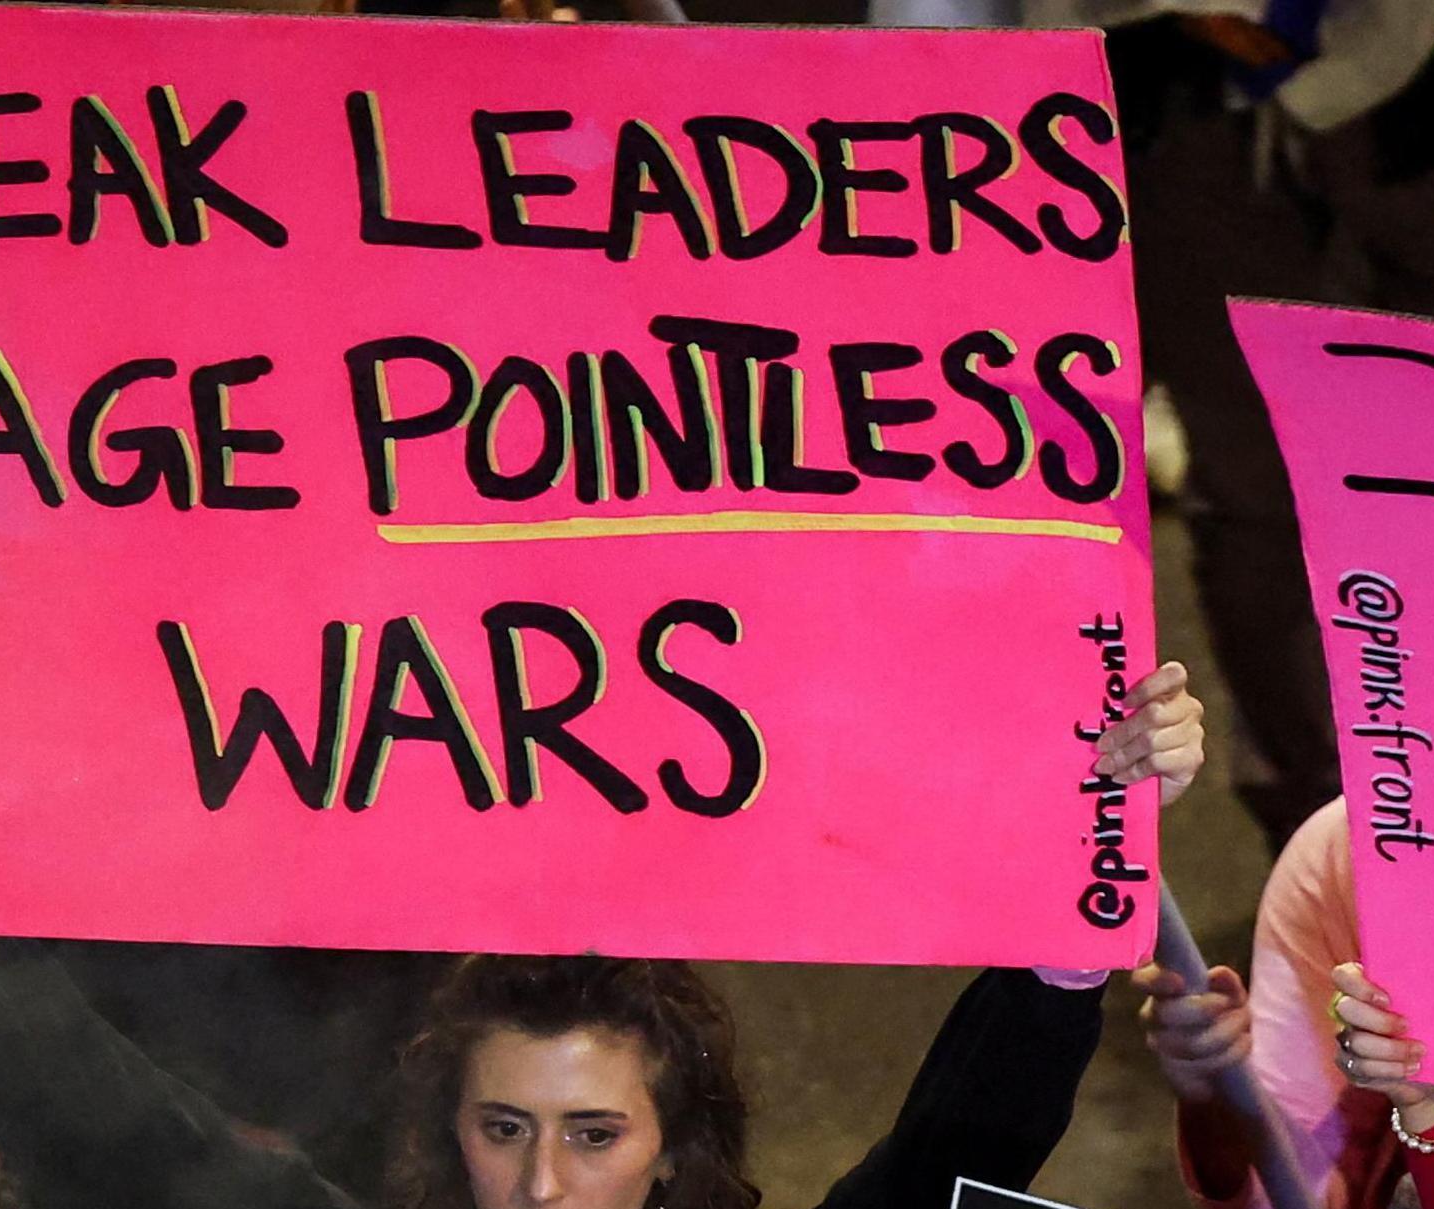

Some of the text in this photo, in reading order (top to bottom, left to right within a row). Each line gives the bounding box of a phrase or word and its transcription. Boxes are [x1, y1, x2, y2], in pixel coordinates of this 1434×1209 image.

[345, 89, 1130, 263] LEADERS
[346, 314, 1124, 516] POINTLESS
[157, 598, 768, 818] WARS
